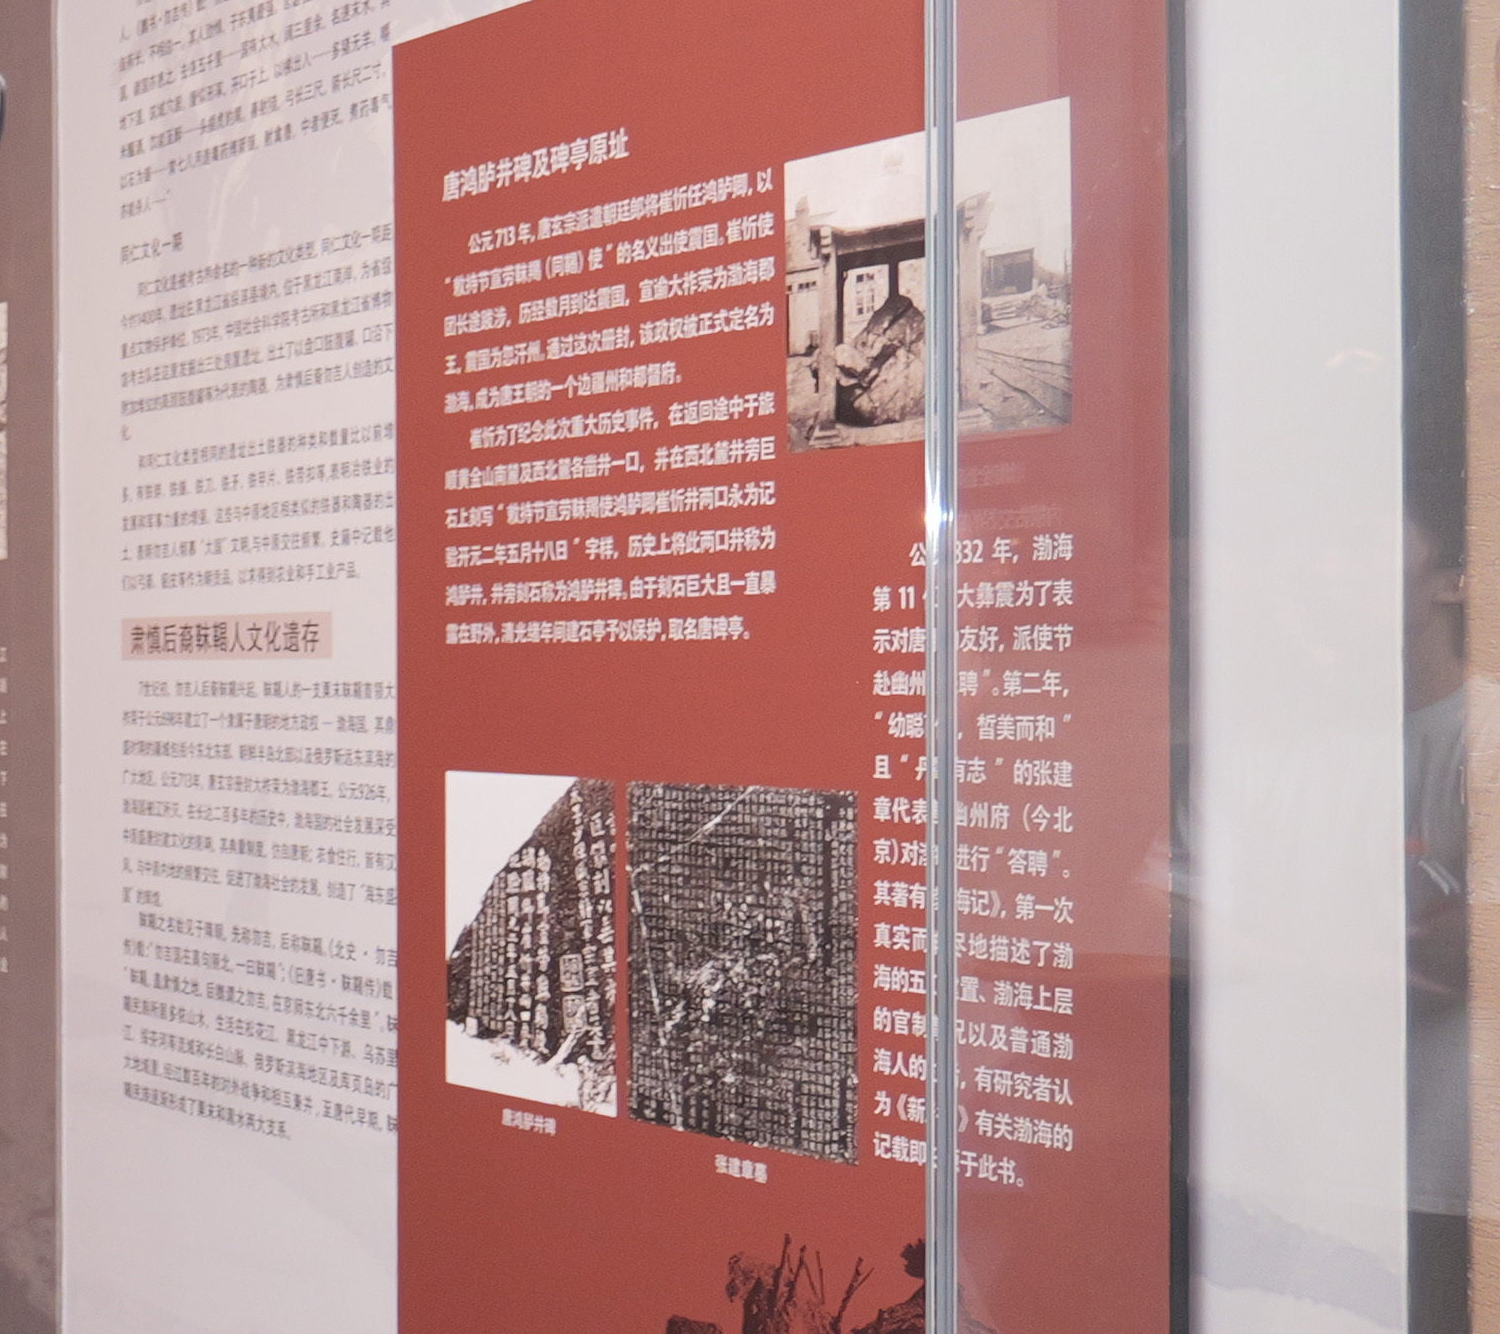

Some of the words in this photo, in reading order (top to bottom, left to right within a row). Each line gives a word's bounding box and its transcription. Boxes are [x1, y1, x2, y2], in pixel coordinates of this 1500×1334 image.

[130, 620, 319, 655] 肃慎后裔靺鞨人文化遗存
